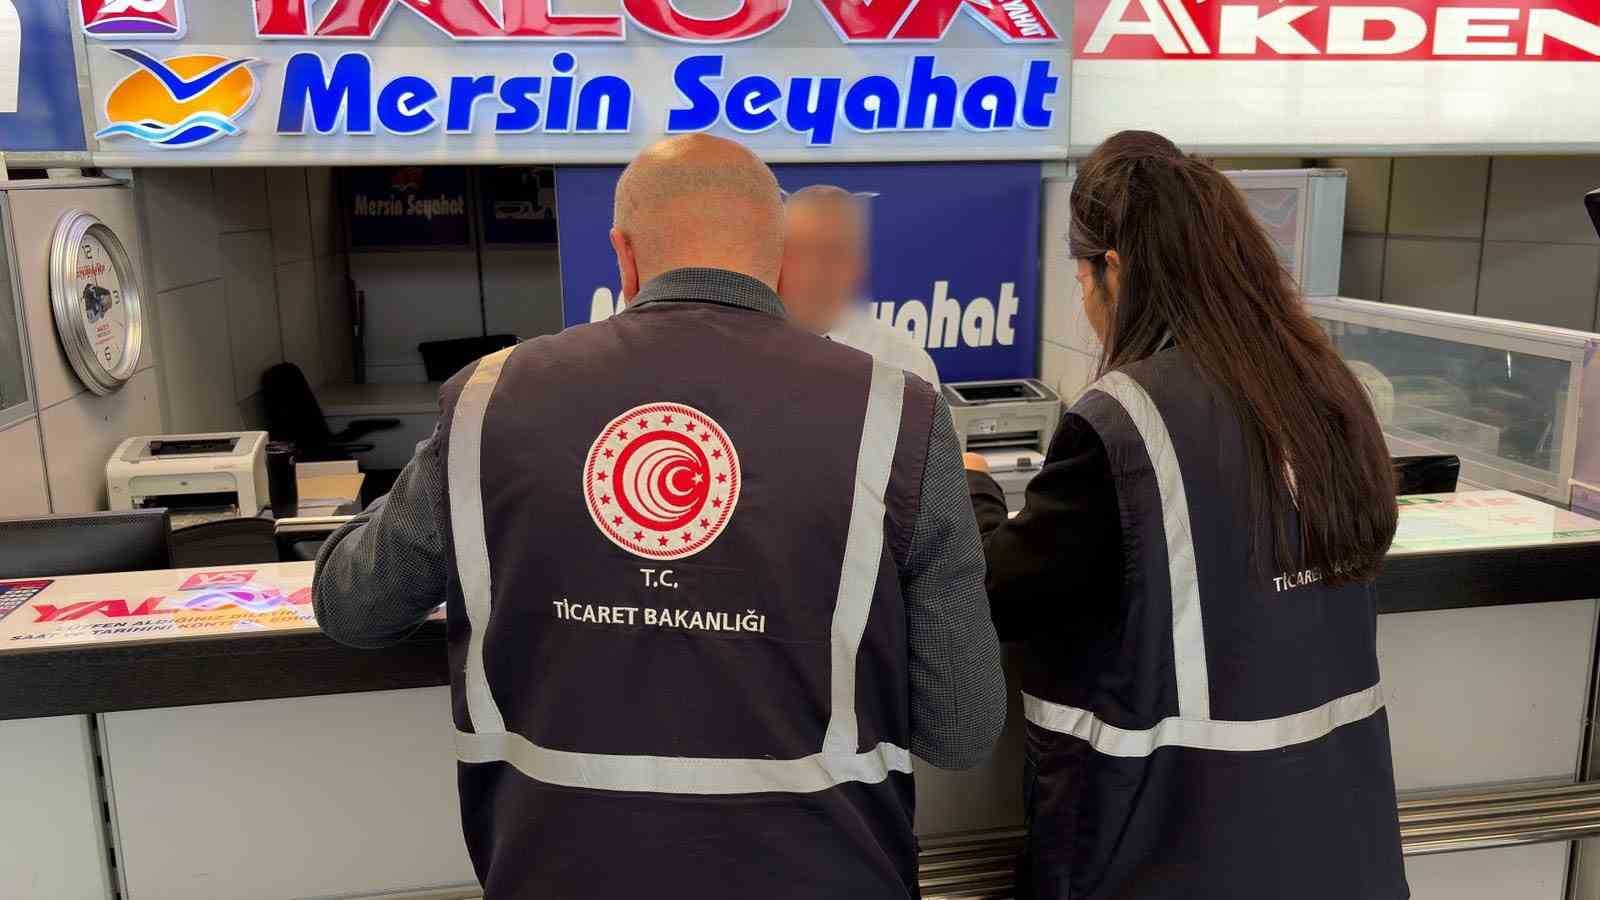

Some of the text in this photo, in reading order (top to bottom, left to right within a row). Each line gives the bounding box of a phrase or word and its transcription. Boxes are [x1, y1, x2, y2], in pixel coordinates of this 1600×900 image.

[276, 51, 1059, 145] Mersin Seyahat
[354, 194, 465, 220] Mersin Seyahat
[640, 568, 679, 588] T.C.
[553, 598, 766, 632] TİCARET BAKANLIĞI
